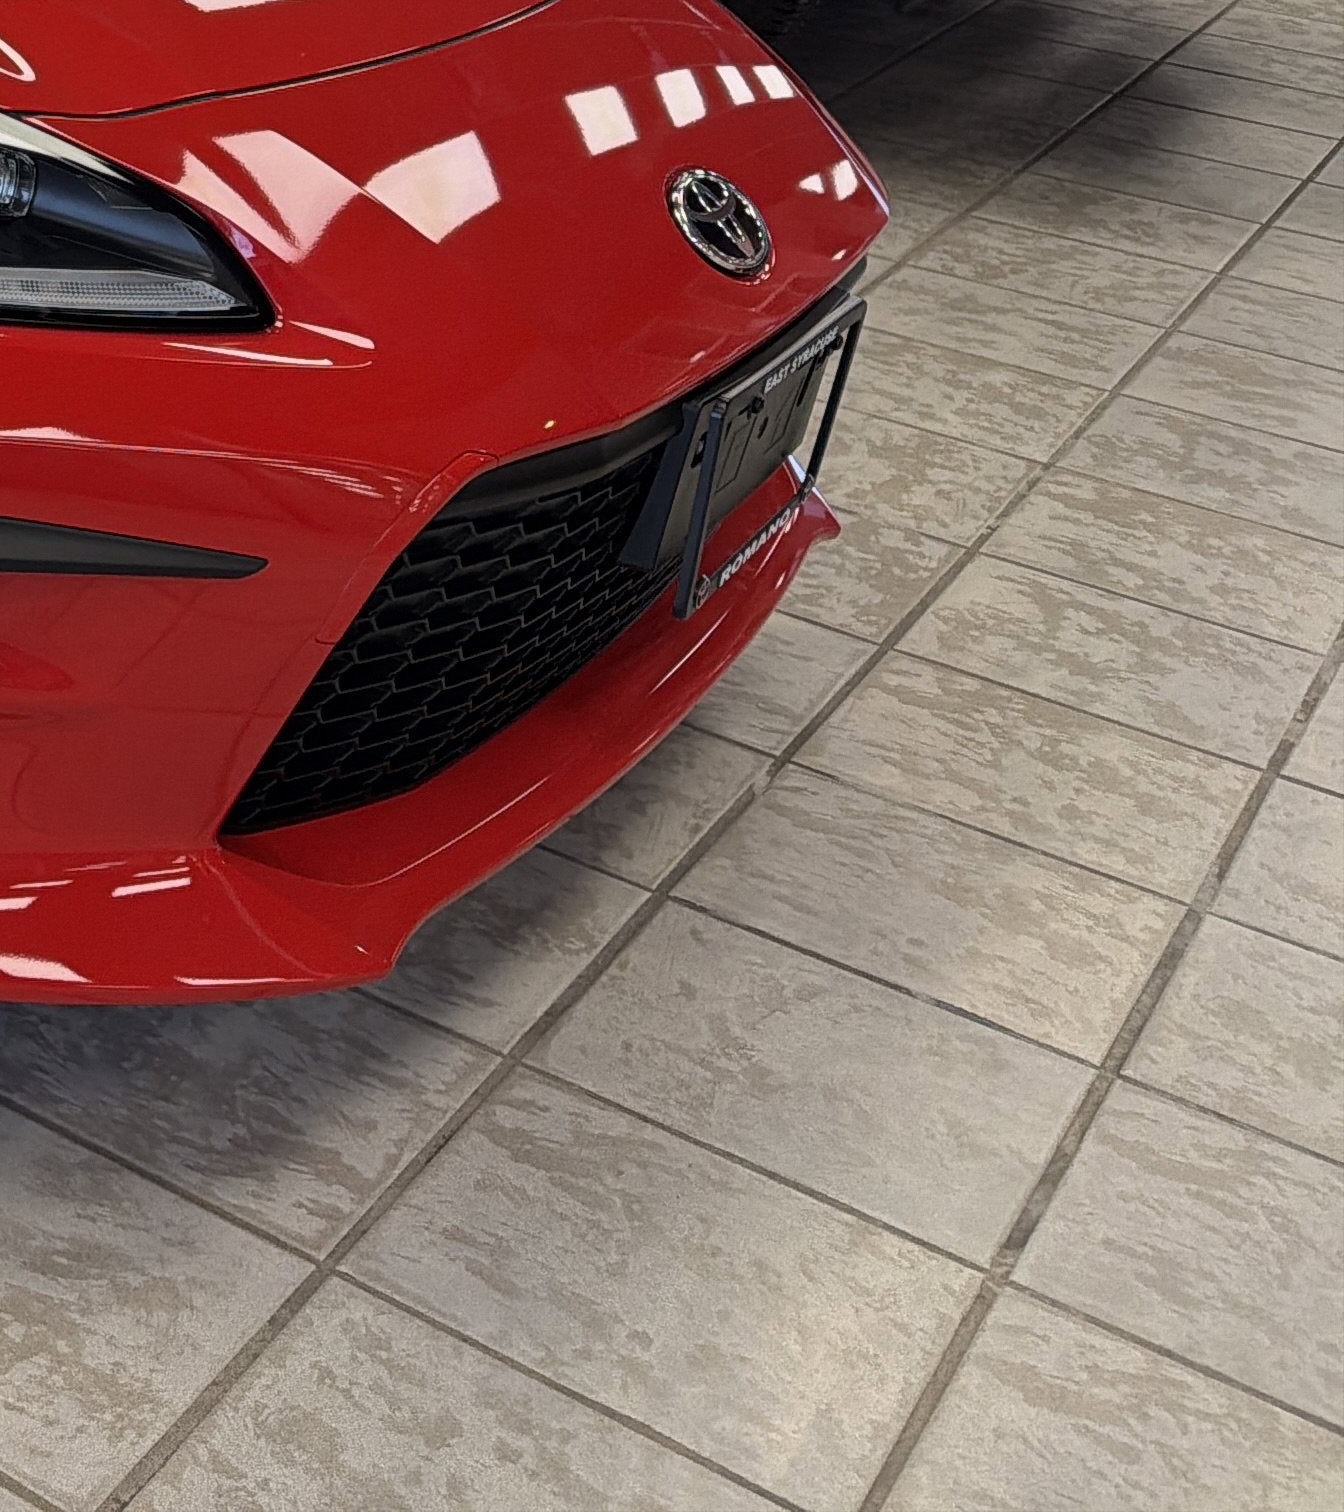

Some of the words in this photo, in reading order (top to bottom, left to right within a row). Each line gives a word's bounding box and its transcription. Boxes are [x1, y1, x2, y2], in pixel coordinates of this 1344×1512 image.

[764, 362, 791, 394] EAST
[791, 325, 840, 374] SYRACUSE
[719, 507, 791, 588] ROMANO
